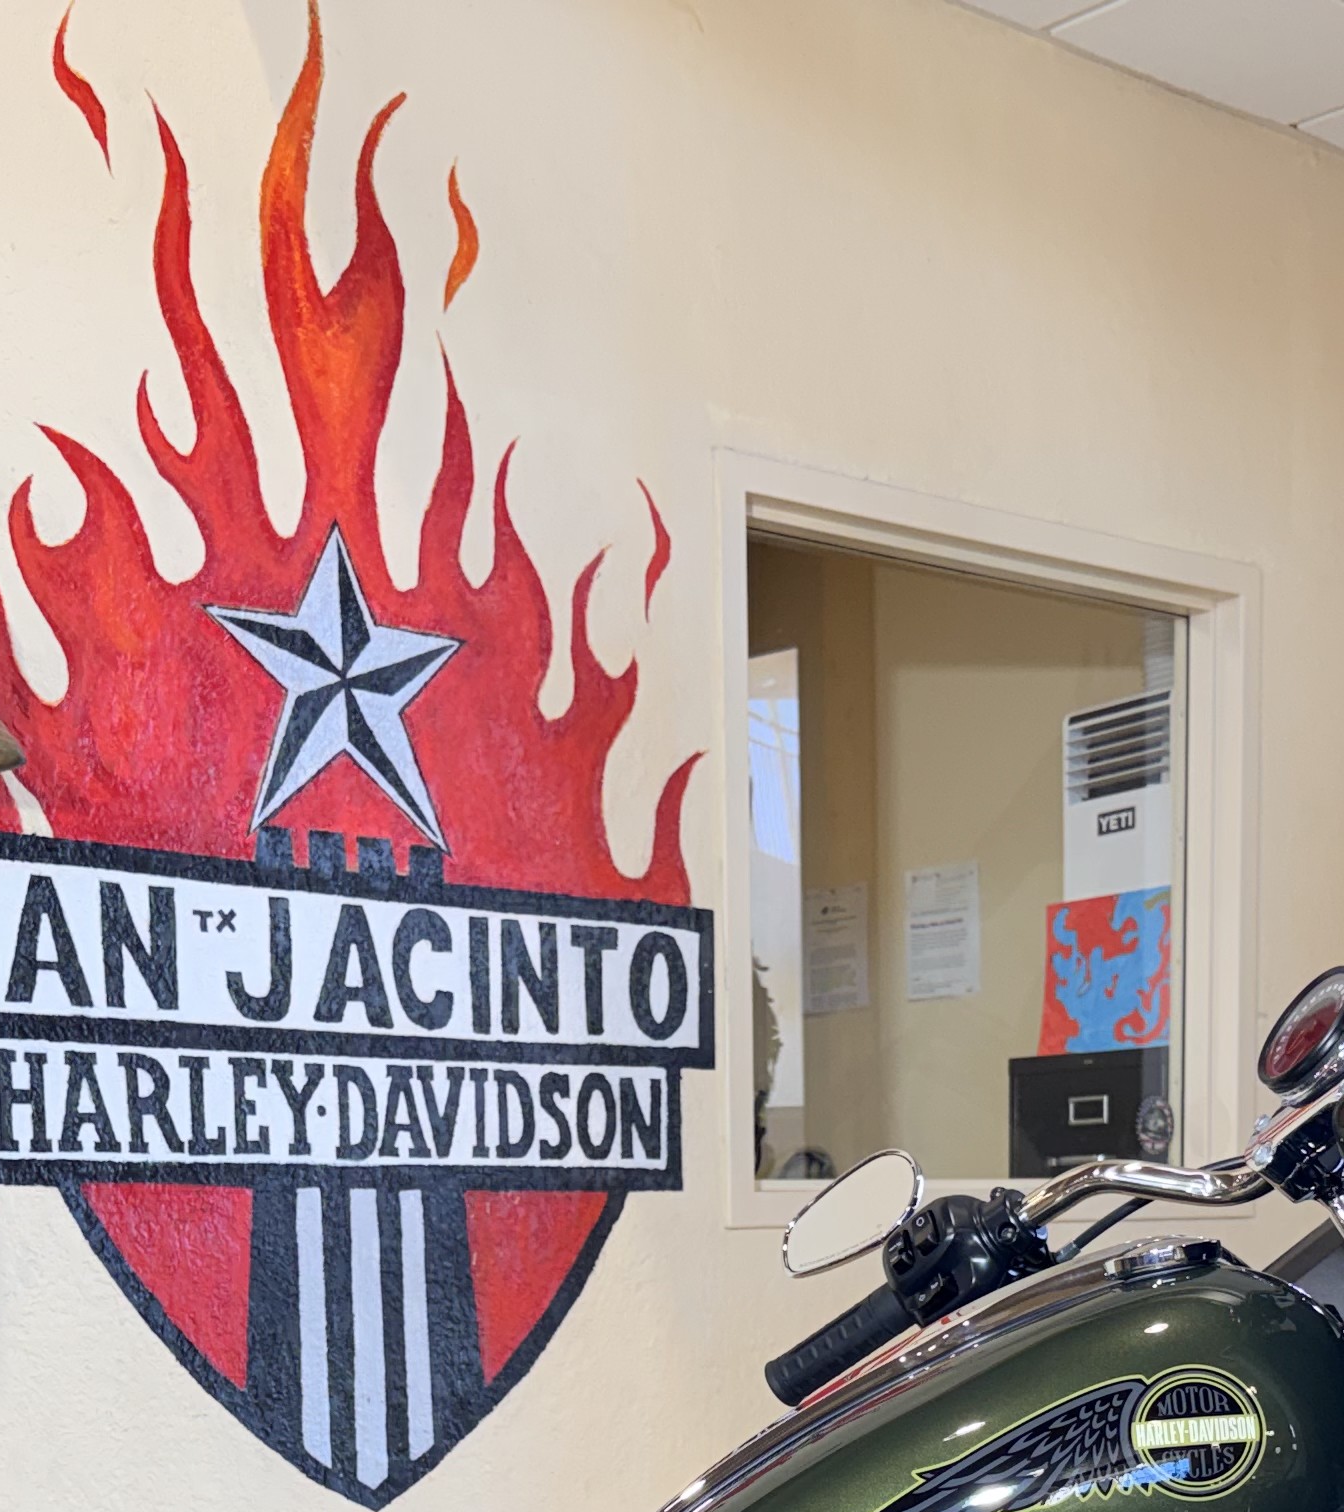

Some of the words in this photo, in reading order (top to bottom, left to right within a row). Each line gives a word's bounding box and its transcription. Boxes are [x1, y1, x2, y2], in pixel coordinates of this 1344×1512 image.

[1099, 811, 1134, 834] YETI
[193, 908, 237, 935] TX
[226, 897, 689, 1041] JACINTO
[1157, 1386, 1230, 1416] MOTOR
[1135, 1416, 1256, 1448] HARLEY-DAVIDSON
